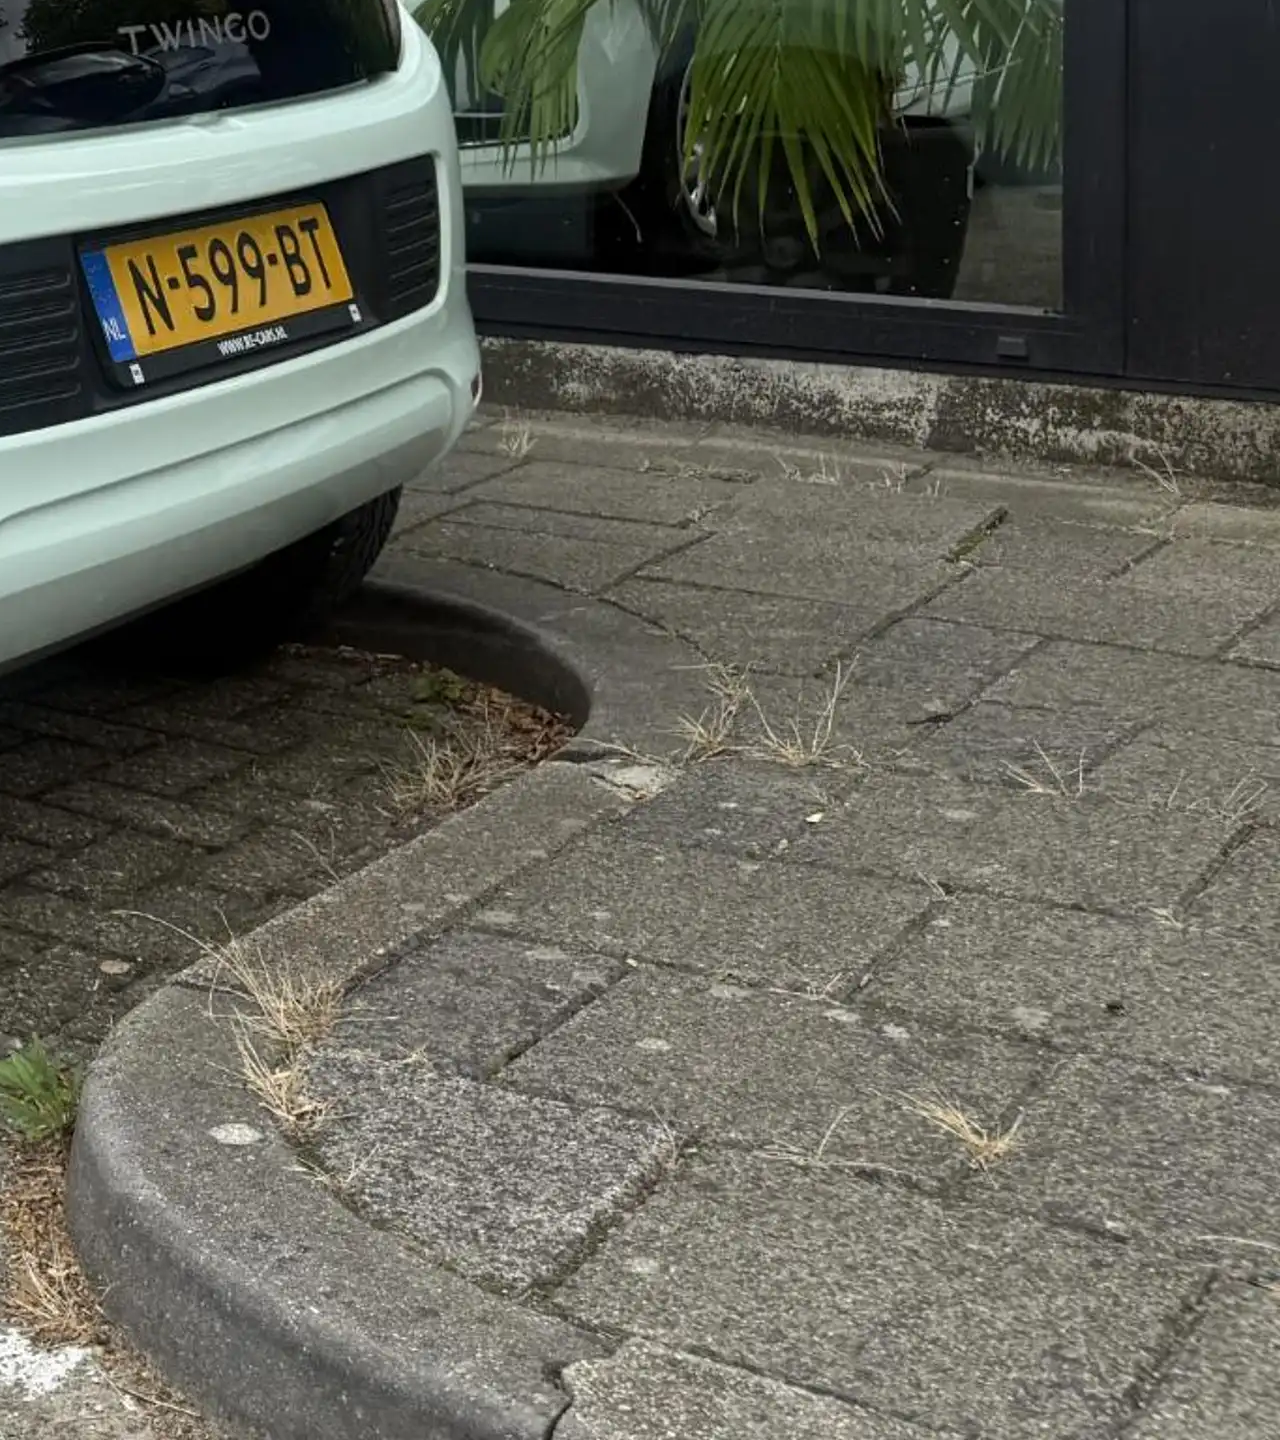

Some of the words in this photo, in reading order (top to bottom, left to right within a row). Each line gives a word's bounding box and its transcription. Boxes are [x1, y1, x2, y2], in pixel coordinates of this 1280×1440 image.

[117, 10, 271, 56] TWINGO
[101, 316, 127, 343] NL
[126, 217, 332, 336] N-599-BT
